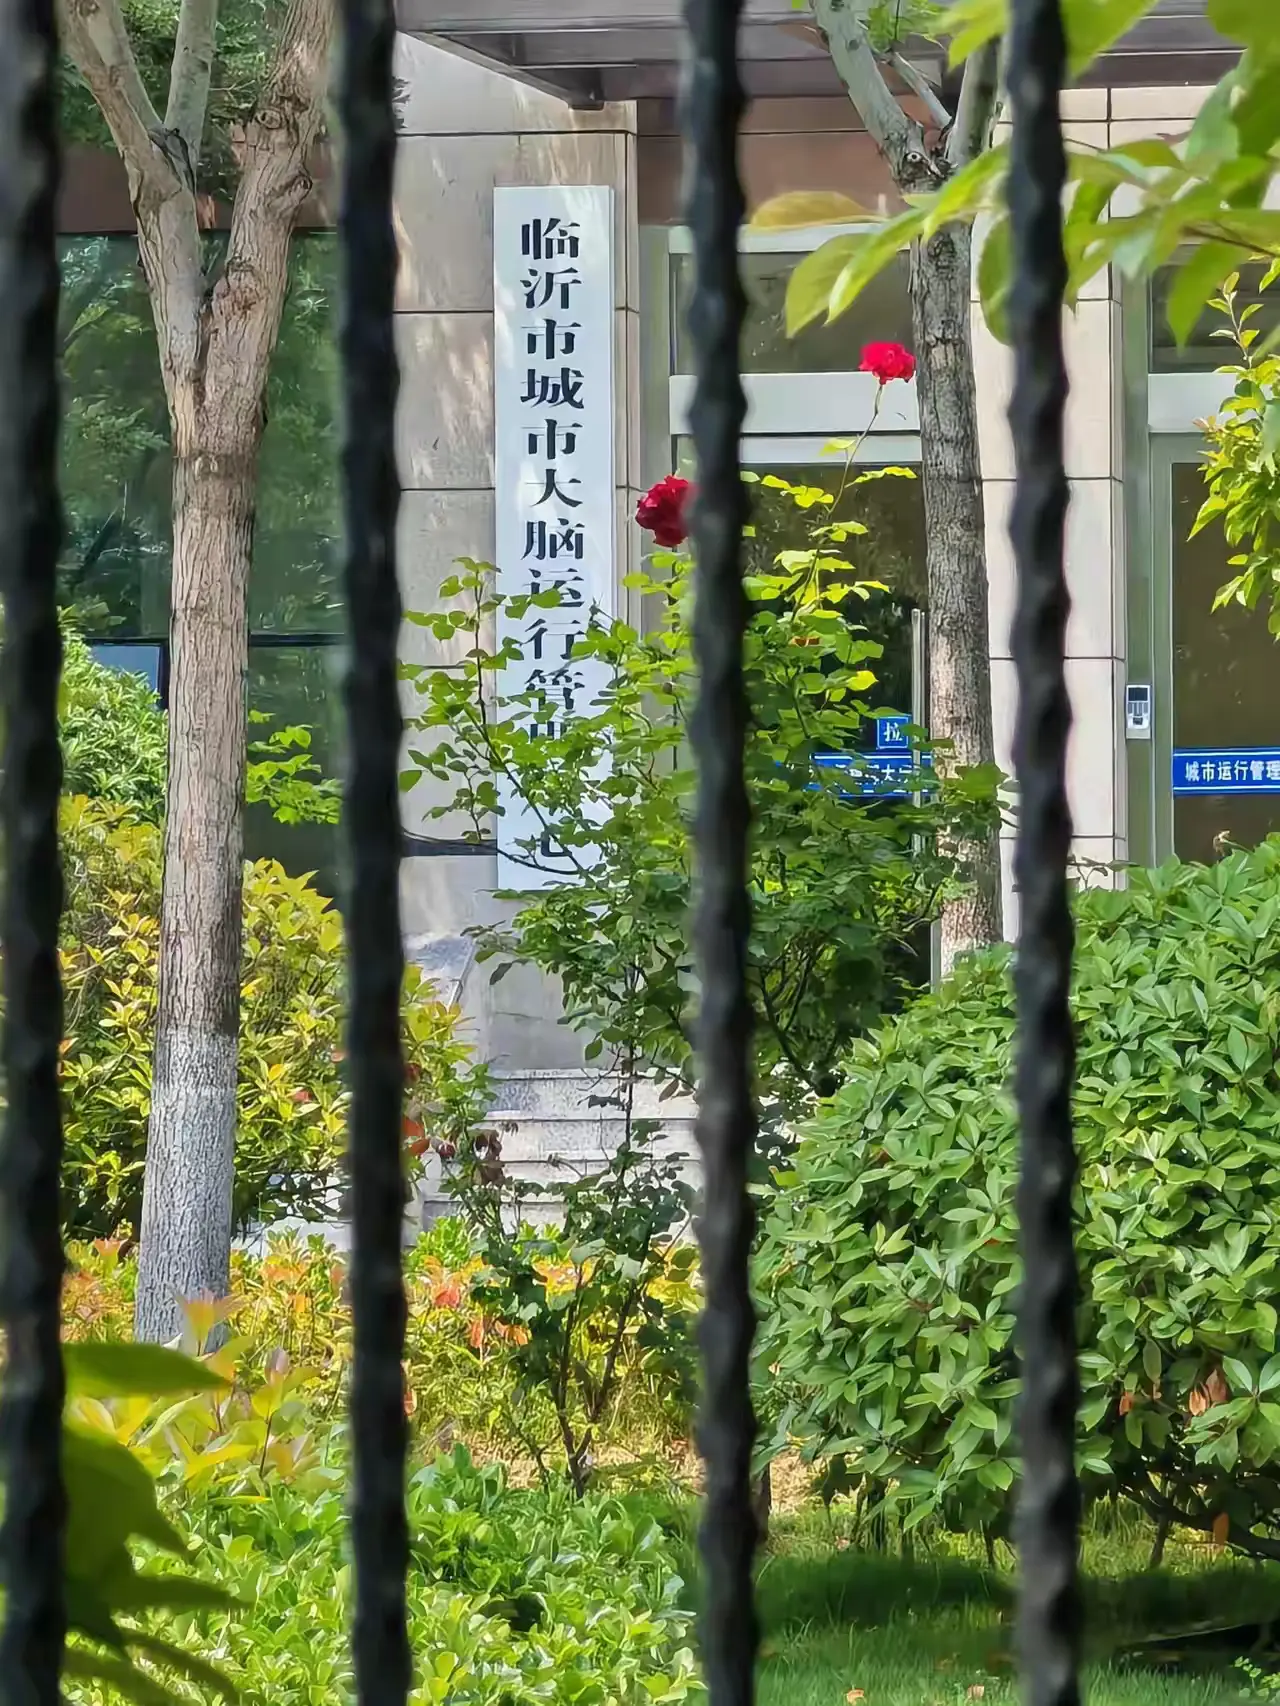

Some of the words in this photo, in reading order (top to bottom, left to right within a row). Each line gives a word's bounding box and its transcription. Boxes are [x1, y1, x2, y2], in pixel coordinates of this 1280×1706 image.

[519, 217, 585, 858] 临沂市城市大脑运行管
[883, 721, 903, 742] 拉
[1184, 759, 1280, 782] 城市运行管理
